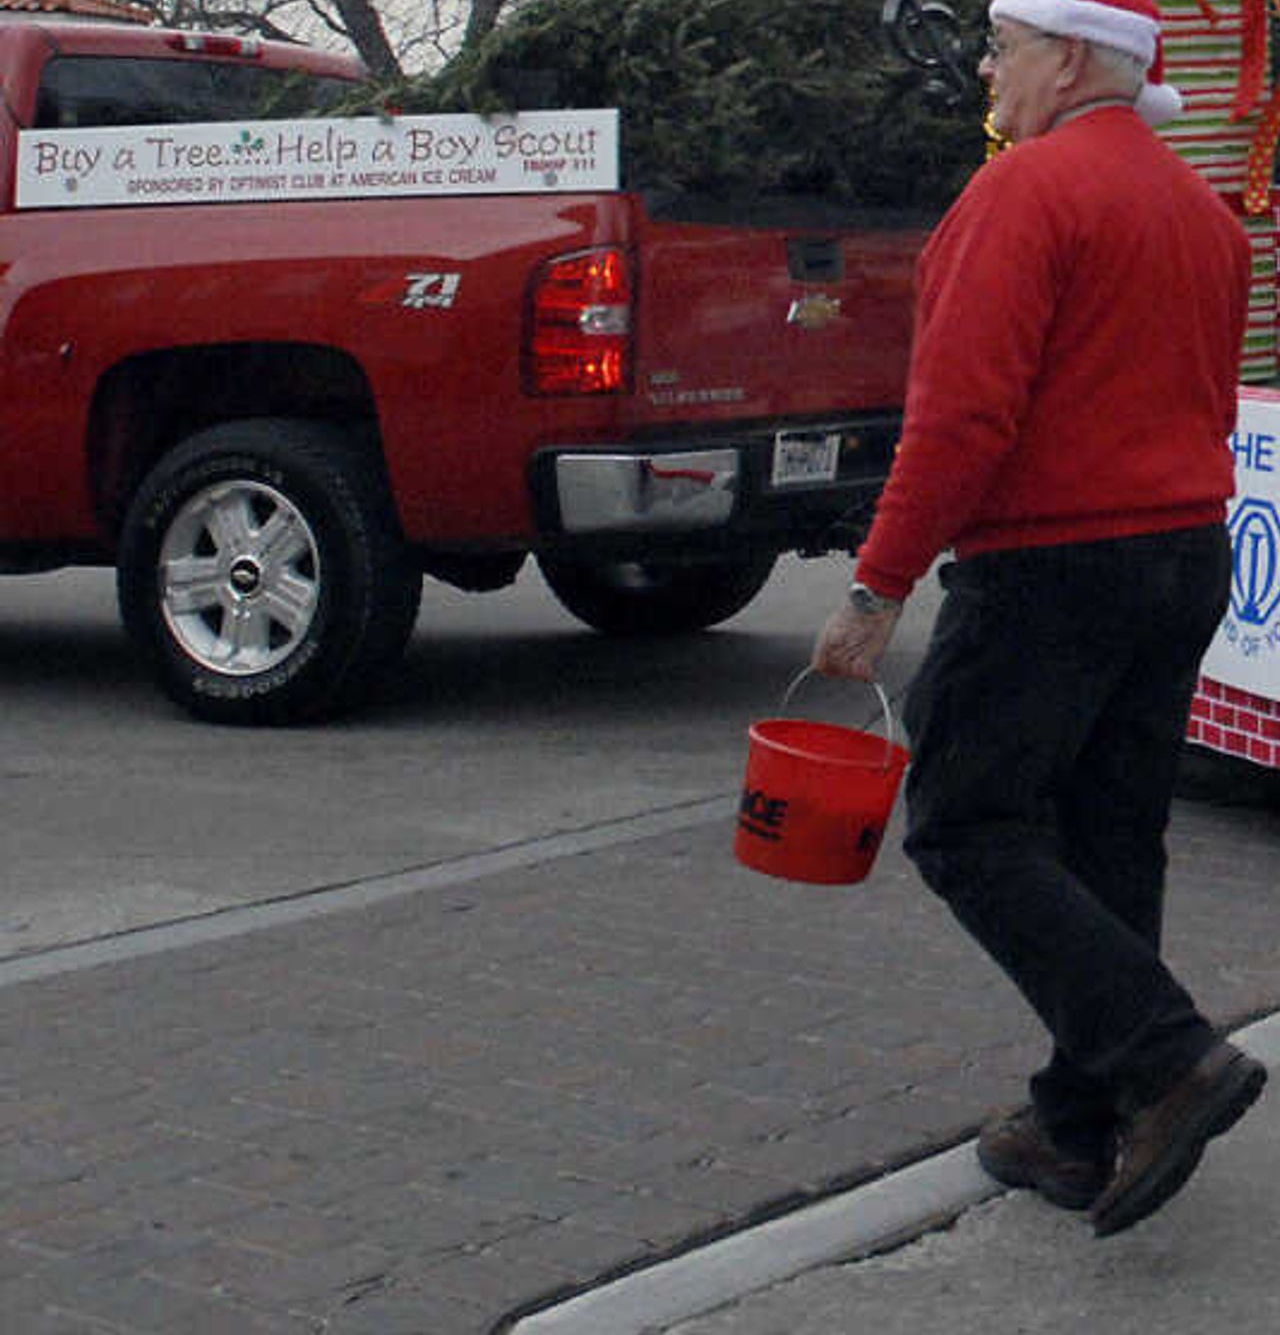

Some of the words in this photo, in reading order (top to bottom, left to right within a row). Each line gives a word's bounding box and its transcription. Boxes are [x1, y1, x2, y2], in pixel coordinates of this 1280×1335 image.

[33, 141, 101, 178] Buy
[112, 147, 136, 170] a
[277, 127, 357, 167] Help
[371, 138, 395, 162] a
[406, 128, 481, 164] Boy
[494, 124, 597, 159] Scout
[126, 176, 203, 194] SPONSORED
[229, 174, 286, 191] OPTIMIST
[290, 173, 326, 189] CLUB
[350, 171, 418, 187] AMERICAN
[422, 169, 444, 184] ICE
[449, 167, 498, 184] CREAM
[1232, 432, 1276, 472] HE
